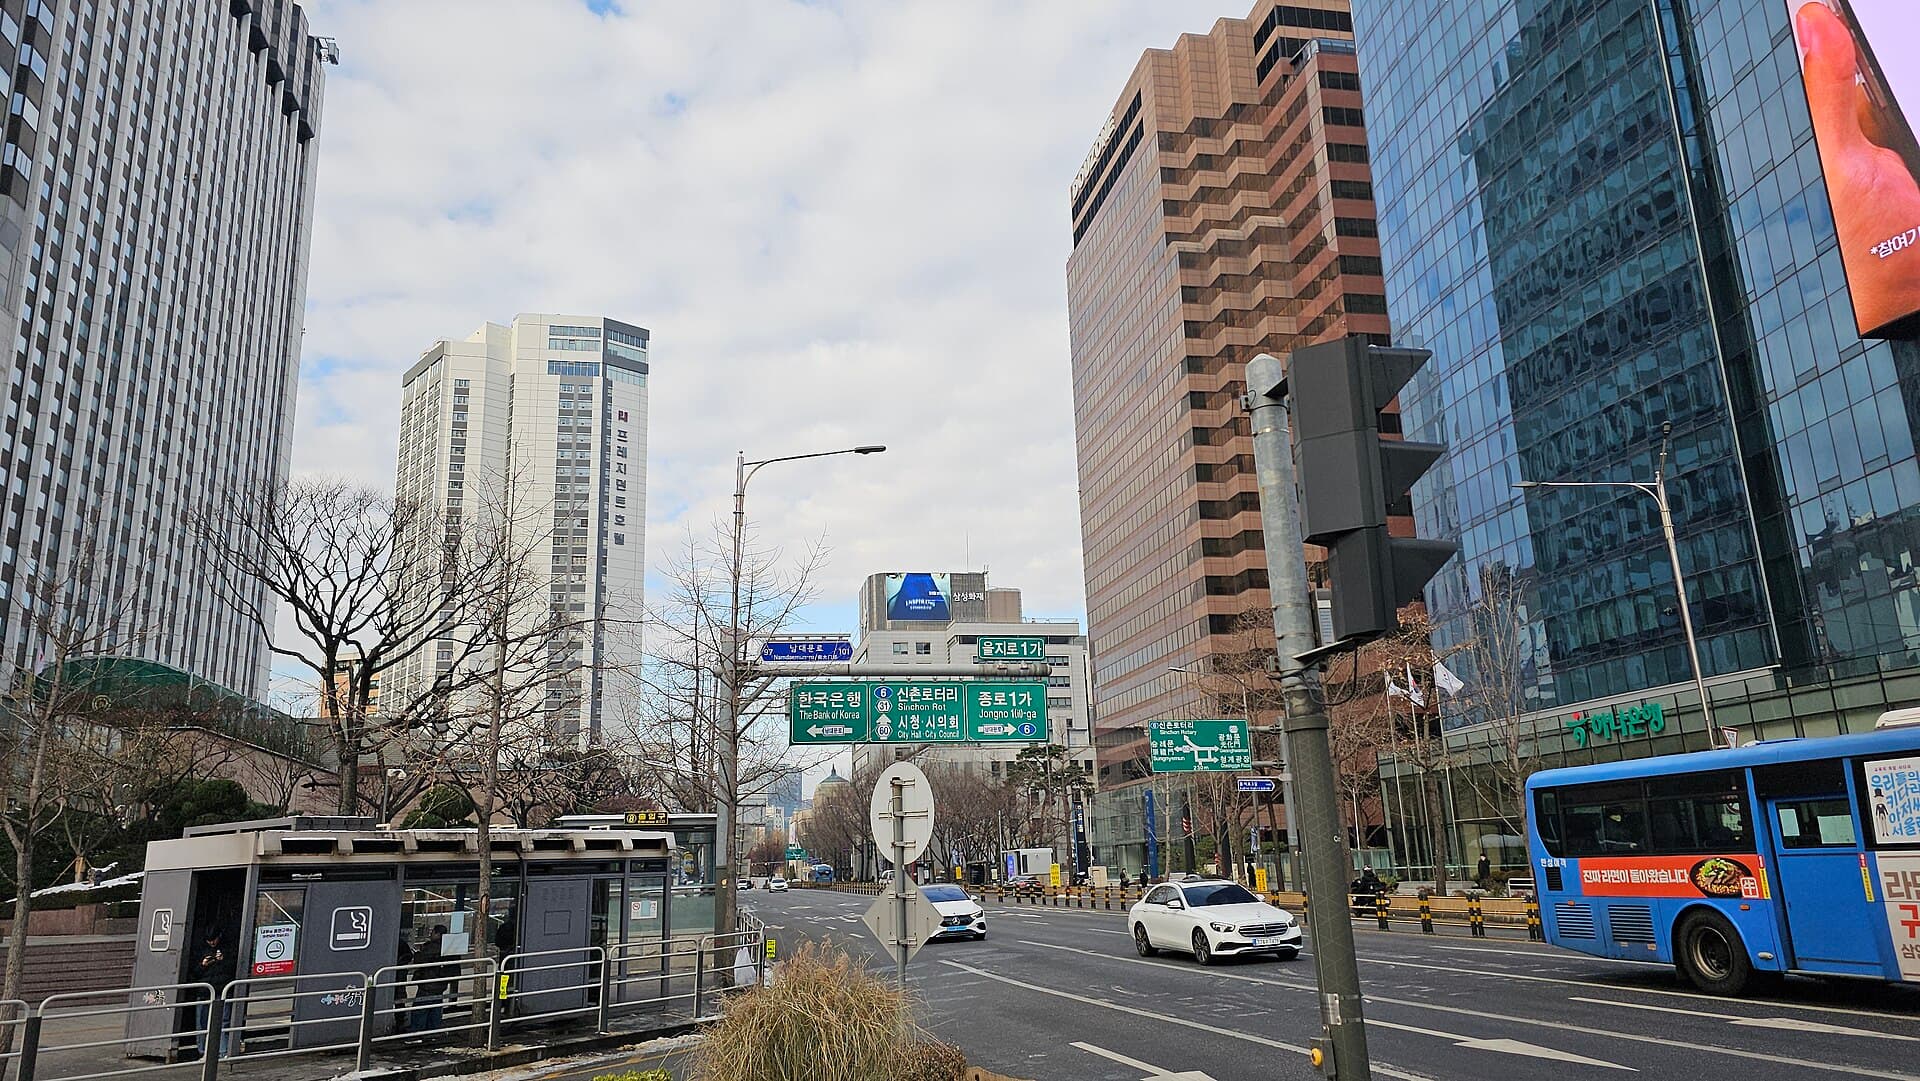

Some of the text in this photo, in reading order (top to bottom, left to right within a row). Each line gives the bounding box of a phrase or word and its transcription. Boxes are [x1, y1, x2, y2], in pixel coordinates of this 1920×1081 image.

[952, 591, 984, 602] 삼성화재
[789, 643, 824, 653] 남대문로
[838, 648, 850, 656] 101
[880, 687, 887, 698] 6
[897, 686, 958, 702] 신촌로터리
[798, 691, 861, 708] 한국은행
[978, 691, 1032, 707] 종로1가
[878, 701, 889, 711] 31
[897, 703, 946, 711] Sinchon Rot
[799, 710, 860, 720] The Bank of Korea
[979, 709, 1008, 720] Jongno
[1159, 721, 1194, 730] 신촌로터리
[1591, 703, 1664, 739] 하나은행
[879, 726, 889, 735] 60
[1024, 724, 1031, 734] 6
[897, 730, 908, 740] City
[938, 730, 959, 739] Council
[1871, 770, 1920, 791] 우리들의
[1583, 869, 1689, 883] 진짜 라면이 돌아왔습니다
